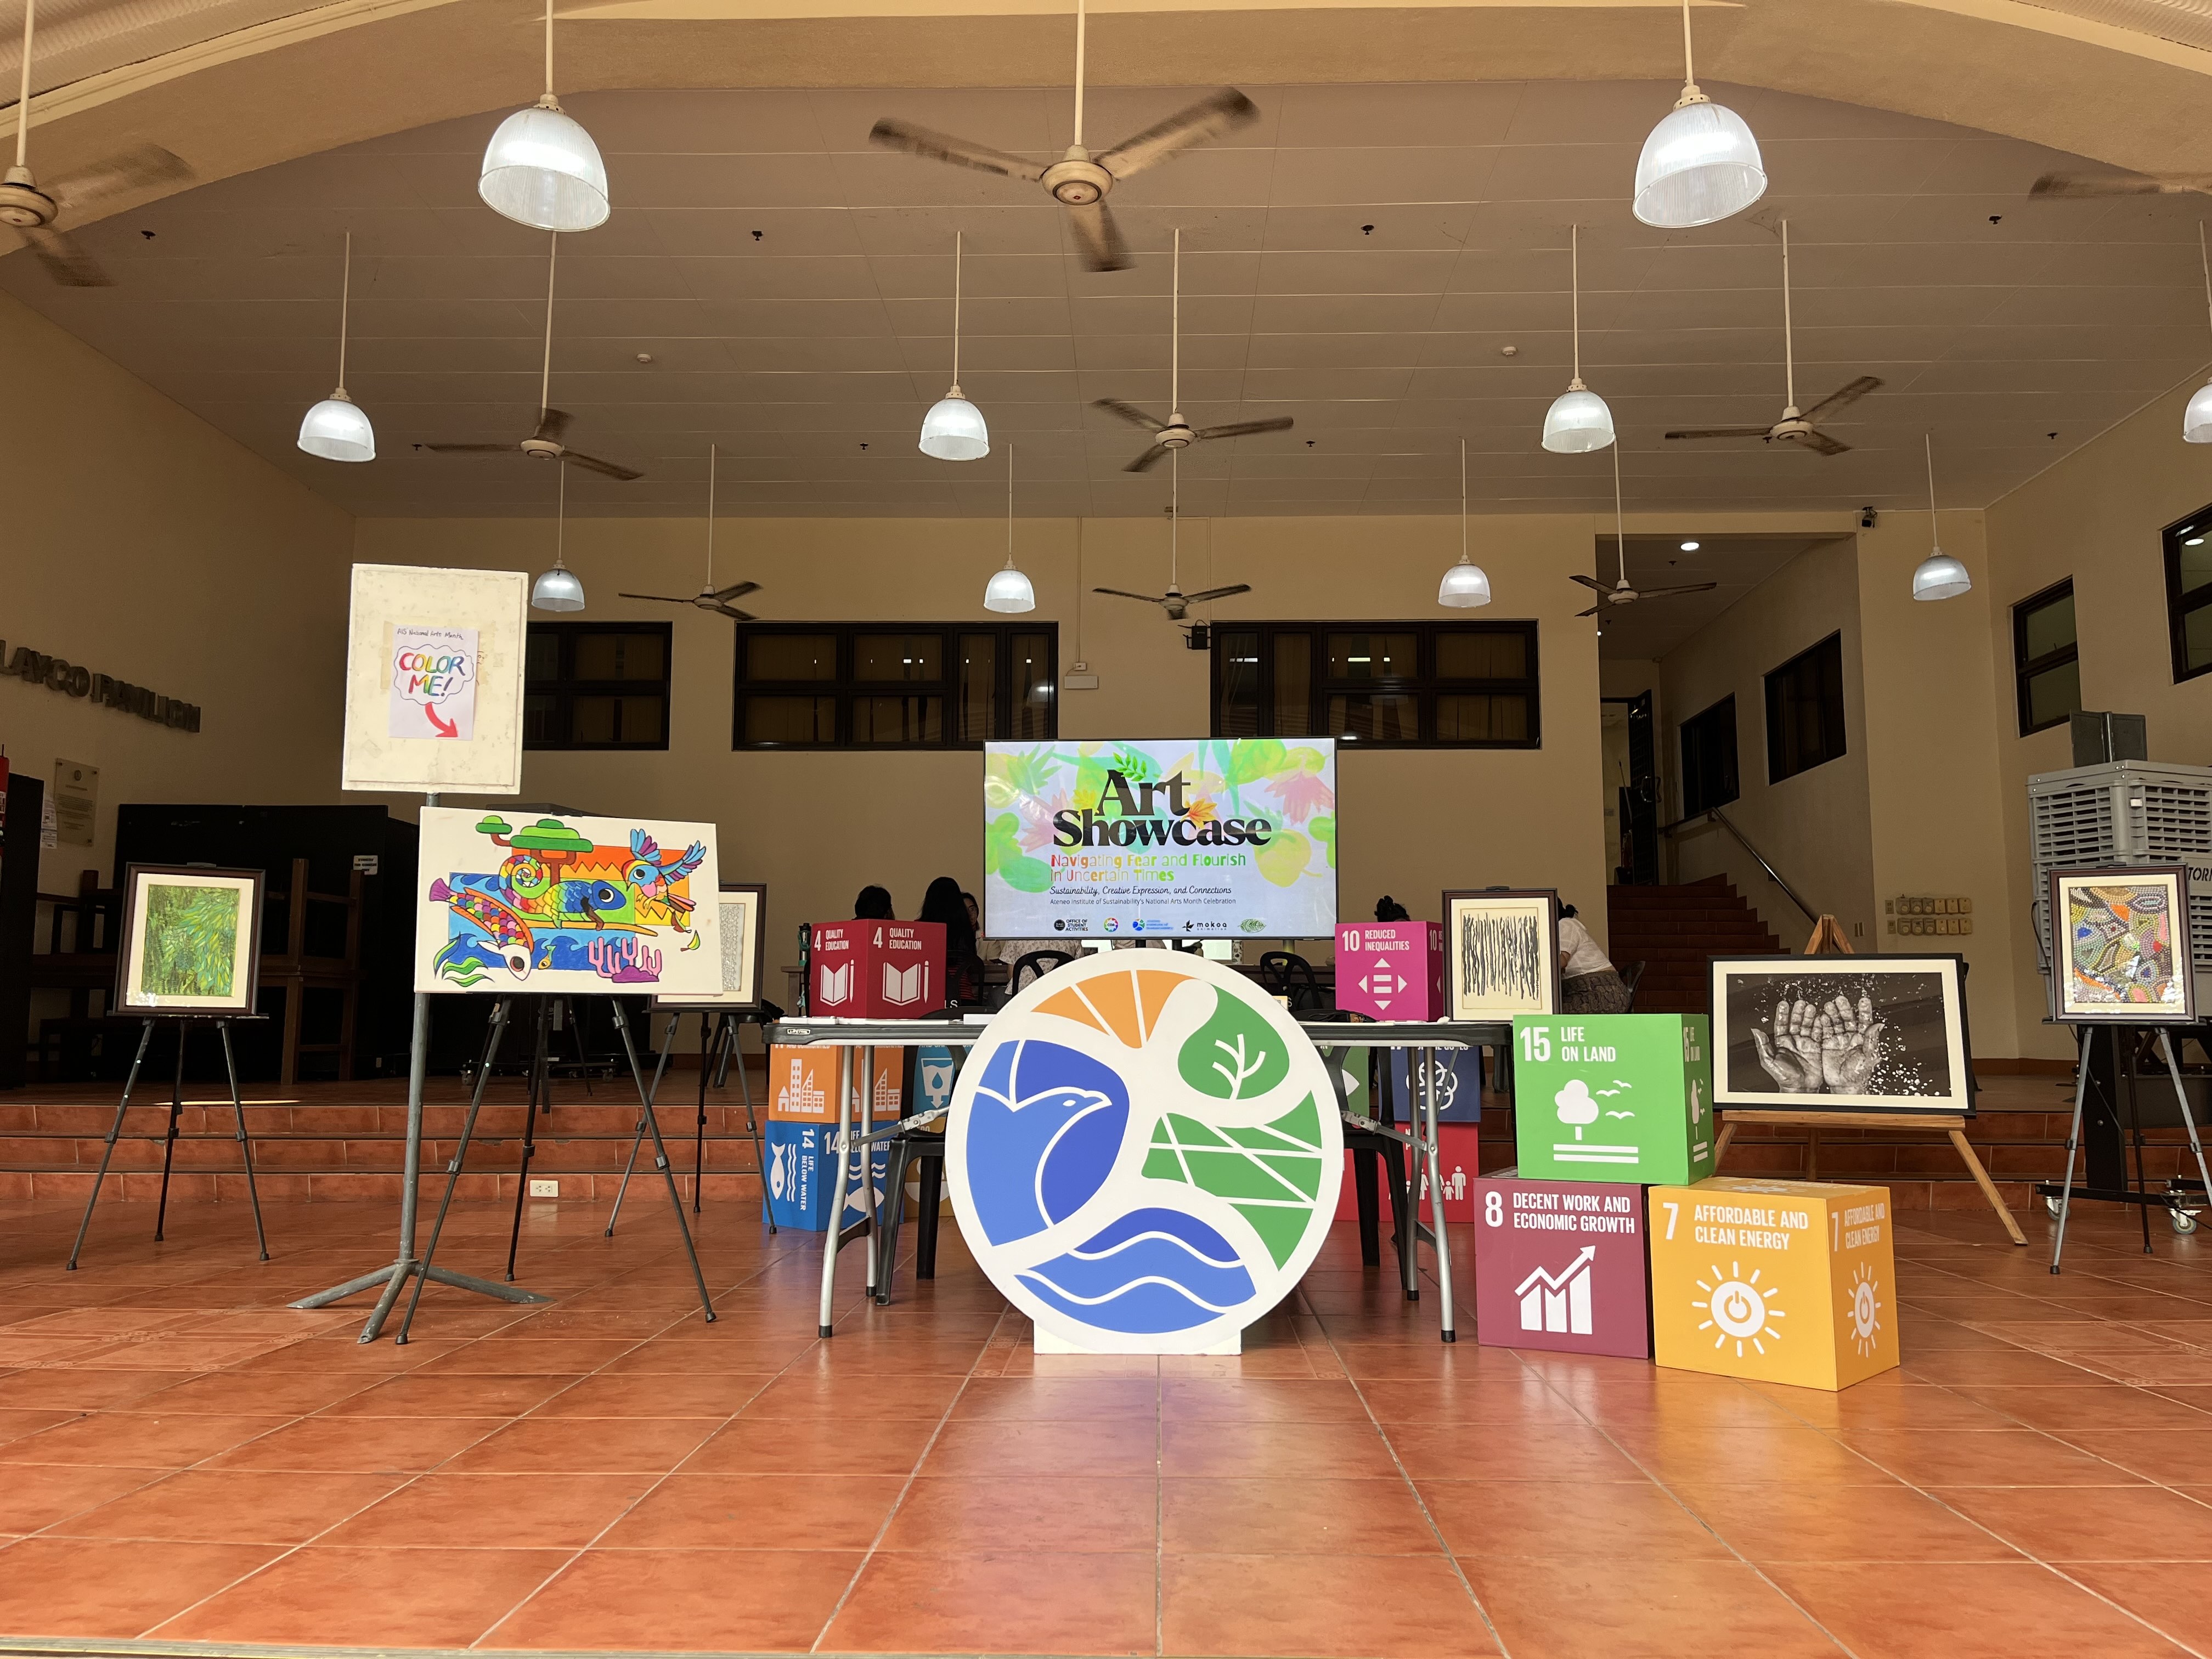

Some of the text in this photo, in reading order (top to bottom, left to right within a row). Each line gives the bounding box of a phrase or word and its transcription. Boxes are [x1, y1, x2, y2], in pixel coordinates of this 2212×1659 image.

[444, 632, 464, 640] Month
[399, 652, 466, 676] COLOR
[408, 674, 453, 697] ME!
[91, 673, 201, 733] PAVILION
[1094, 769, 1191, 816] Art
[1053, 808, 1272, 847] Showcase
[1051, 853, 1246, 868] Navigating Fear and Flourish
[1066, 869, 1128, 882] Uncertain
[1133, 869, 1175, 882] Times
[1049, 885, 1232, 896] Sustainability, Creative Expression, and Connections
[814, 930, 821, 951] 4
[825, 929, 844, 940] QUALITY
[873, 927, 883, 949] 4
[889, 927, 914, 938] QUALITY
[1342, 930, 1360, 952] 10
[1364, 929, 1396, 939] REDUCED
[1429, 929, 1437, 951] 10
[825, 940, 849, 951] EDUCATION
[889, 940, 922, 950] EDUCATION
[1364, 941, 1409, 952] INEQUALITIES
[1520, 1026, 1551, 1062] 15
[1560, 1026, 1585, 1042] LIFE
[1561, 1046, 1616, 1062] ON LAND
[802, 1128, 815, 1149] 14
[1485, 1191, 1504, 1228] 8
[1513, 1192, 1630, 1213] DECENT WORK AND
[1513, 1212, 1635, 1234] ECONOMIC GROWTH
[1662, 1202, 1679, 1240] 7
[1694, 1204, 1808, 1229] AFFORDABLE AND
[1844, 1203, 1885, 1227] AFFORDABLE AND
[1695, 1226, 1790, 1250] CLEAN ENERGY
[1831, 1211, 1838, 1252] 7
[1845, 1225, 1880, 1249] CLEAN ENERGY
